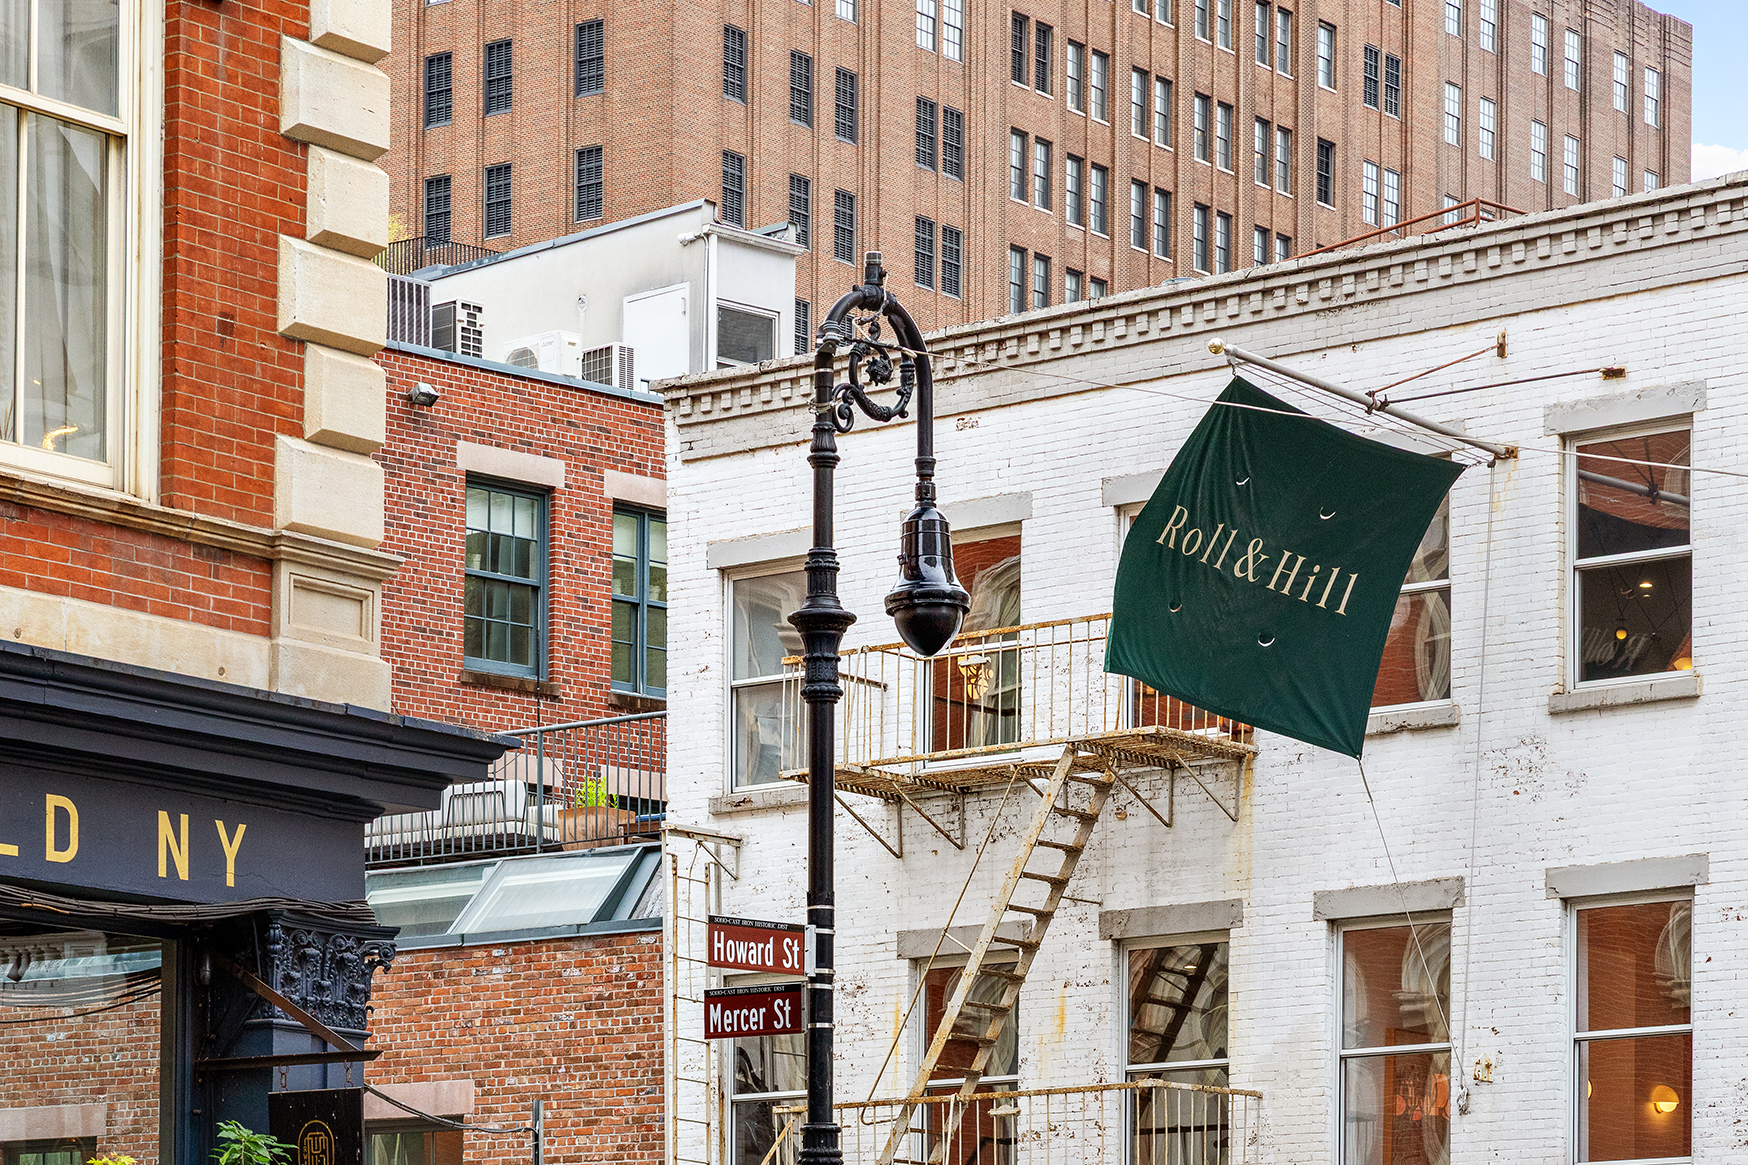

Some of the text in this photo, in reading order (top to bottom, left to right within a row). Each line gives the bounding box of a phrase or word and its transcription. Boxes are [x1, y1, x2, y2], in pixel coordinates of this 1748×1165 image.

[158, 810, 247, 887] NY
[754, 921, 777, 929] HISTORIC
[713, 930, 800, 969] Howard St
[709, 998, 791, 1033] Mercer St
